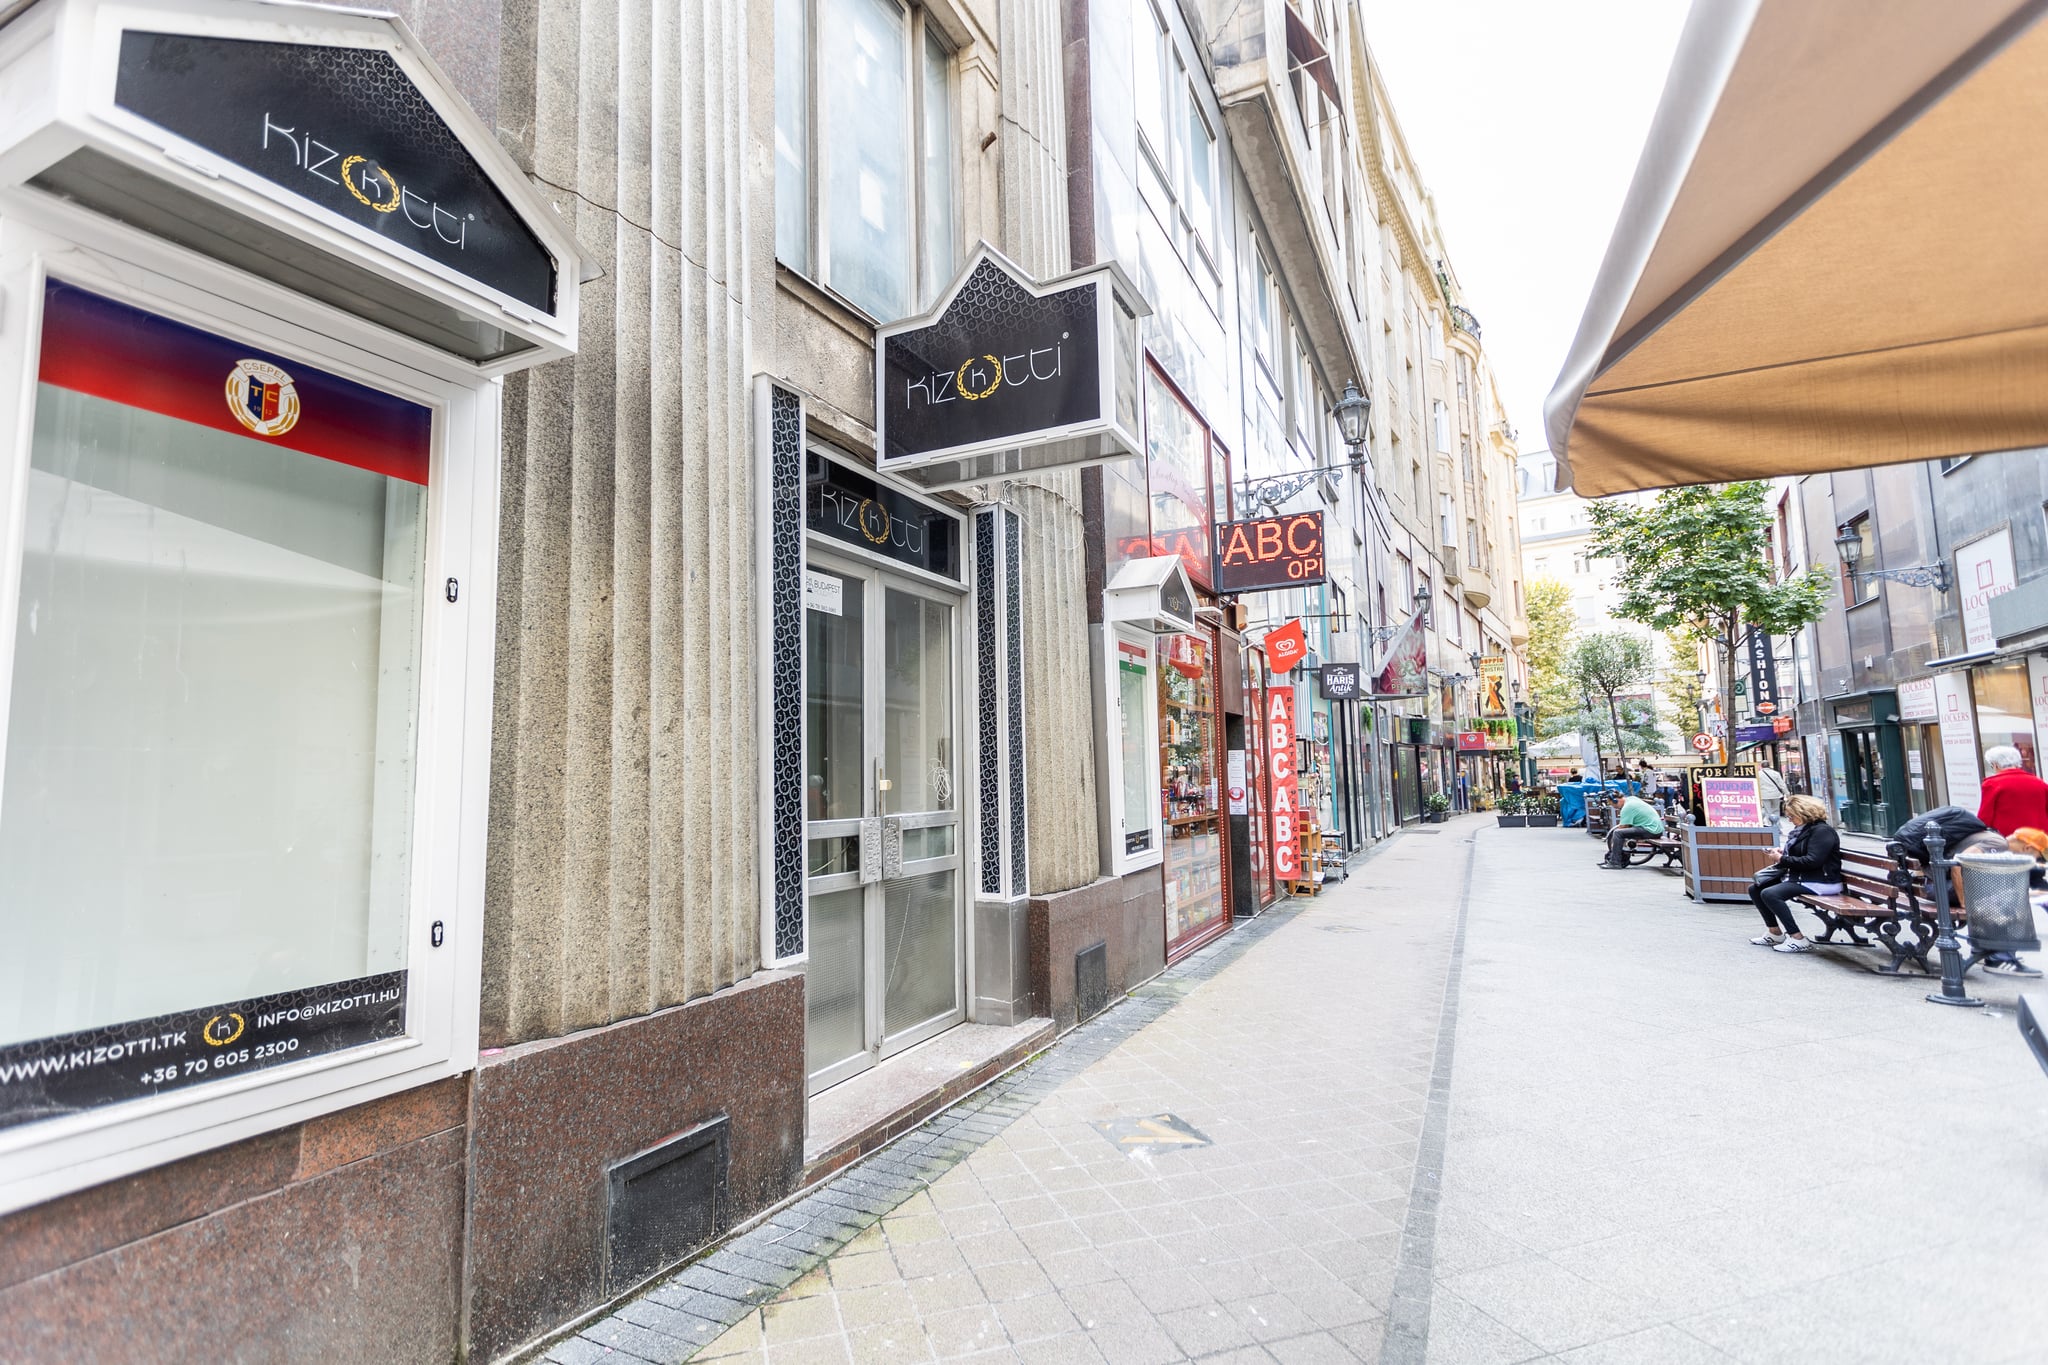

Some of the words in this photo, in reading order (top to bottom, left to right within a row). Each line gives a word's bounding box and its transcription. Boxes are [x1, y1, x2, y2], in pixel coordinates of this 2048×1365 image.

[243, 361, 286, 383] CSEPEL
[1221, 517, 1318, 567] ABC
[1326, 674, 1355, 686] HARIS
[1753, 628, 1771, 701] FASHION
[1329, 684, 1353, 693] Antik
[1270, 694, 1290, 779] ABC
[1707, 794, 1757, 804] GOBELIN
[1275, 785, 1293, 873] ABC
[257, 988, 401, 1029] INFO@KIZOTTI.HU
[141, 1065, 178, 1085] +36
[184, 1059, 208, 1077] 70
[213, 1049, 250, 1069] 605
[254, 1038, 299, 1060] 2300
